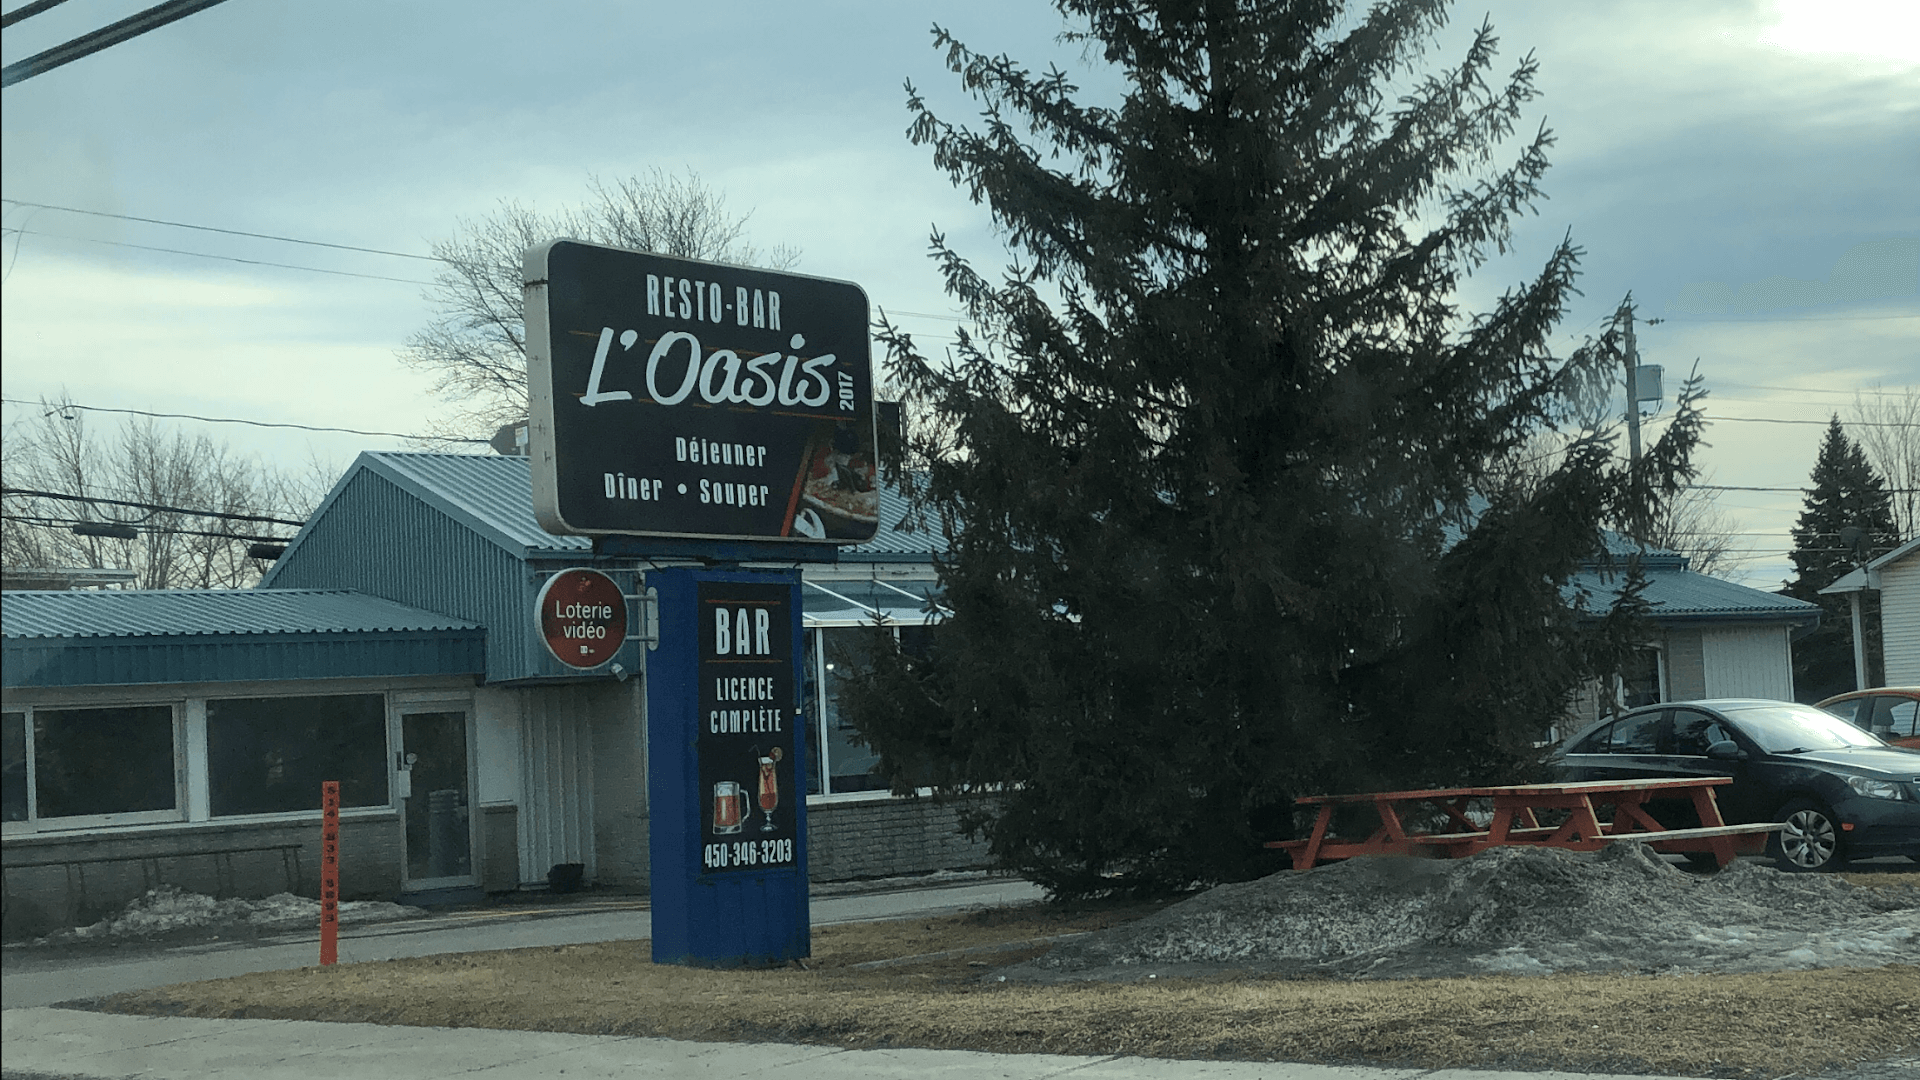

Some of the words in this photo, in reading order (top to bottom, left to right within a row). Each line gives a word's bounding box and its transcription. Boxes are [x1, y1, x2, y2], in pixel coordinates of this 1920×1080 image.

[646, 274, 781, 331] RESTO-BAR
[579, 326, 836, 406] L'Oasis
[838, 371, 854, 410] 2017
[676, 437, 766, 466] Déjeuner
[605, 473, 662, 501] Dîner
[700, 479, 768, 507] Souper
[556, 600, 611, 619] Loterie
[563, 621, 605, 639] vidéo
[716, 608, 770, 654] BAR
[717, 677, 773, 700] LICENCE
[711, 706, 781, 733] COMPLÈTE
[705, 839, 791, 867] 450-346-3203
